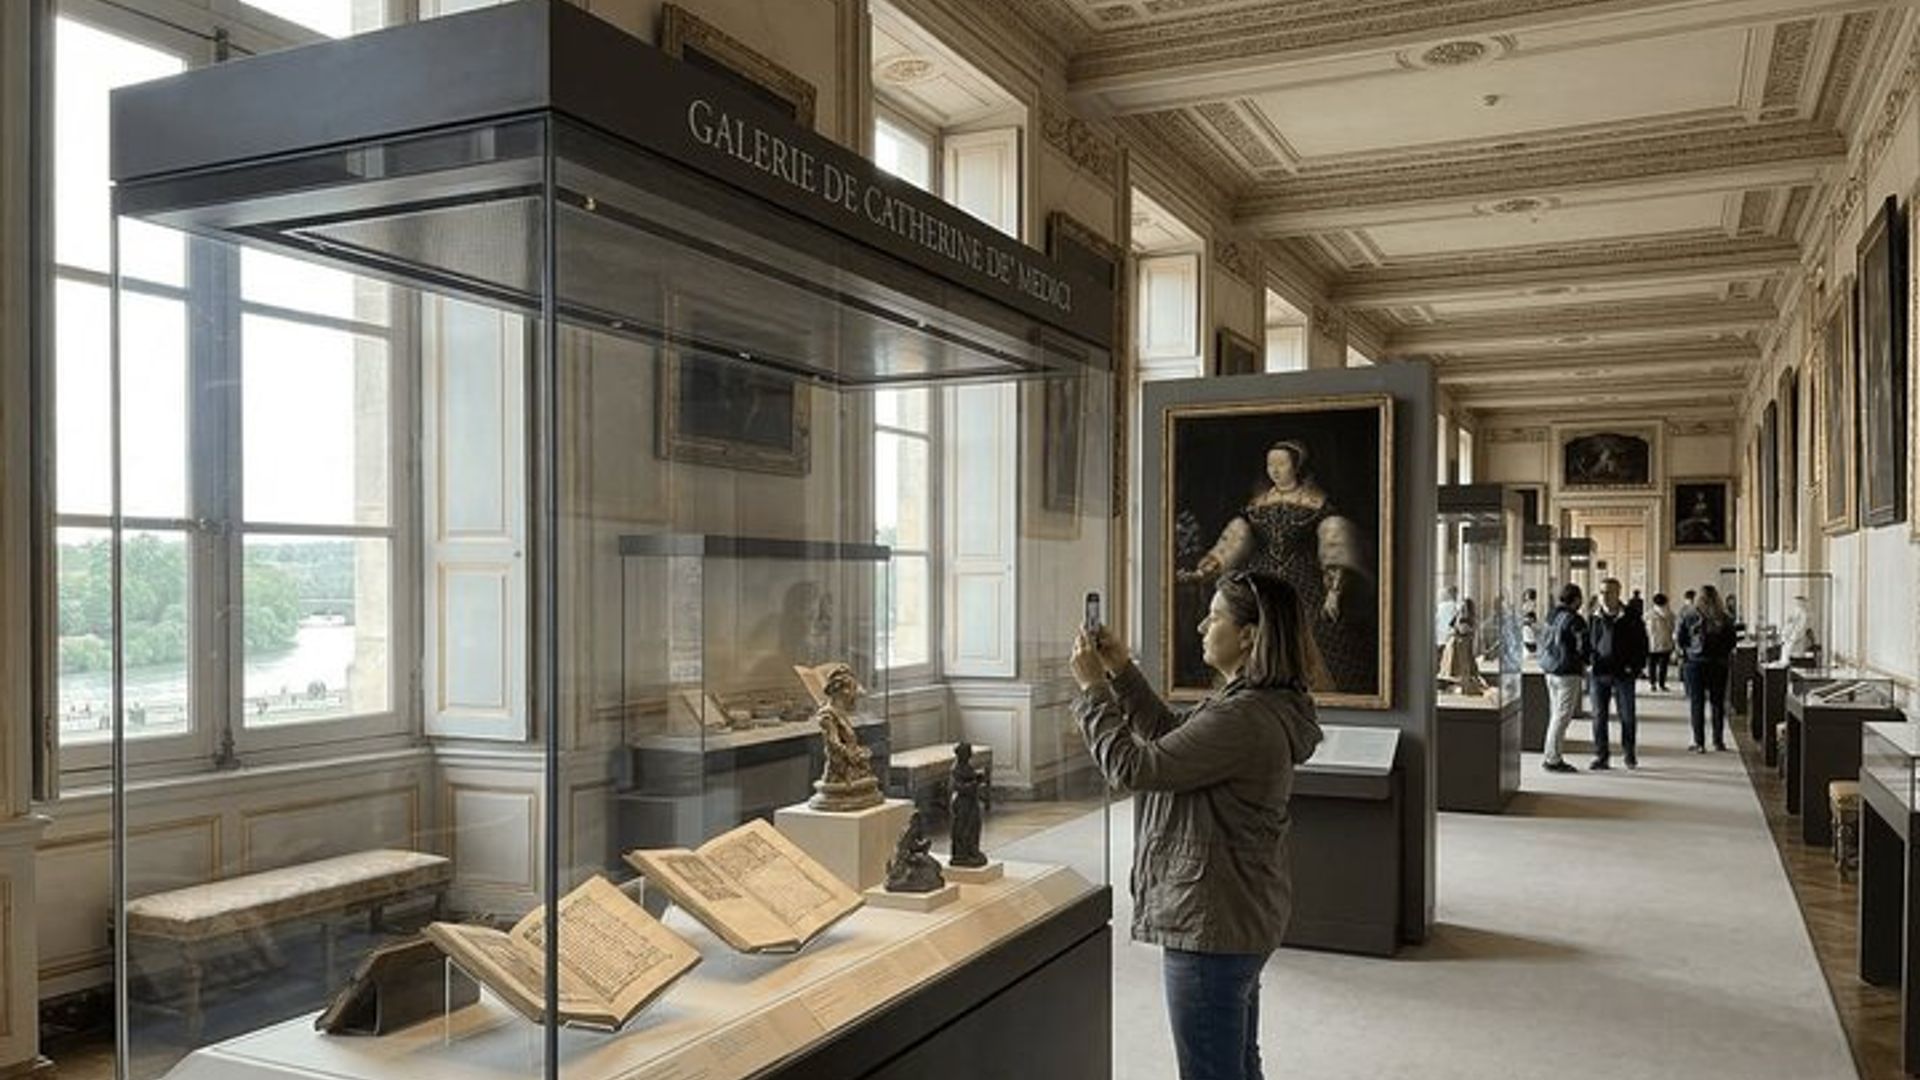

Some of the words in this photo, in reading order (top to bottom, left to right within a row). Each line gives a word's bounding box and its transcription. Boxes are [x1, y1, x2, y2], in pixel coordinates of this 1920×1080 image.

[688, 99, 815, 193] GALERIE
[823, 163, 859, 213] DE
[863, 185, 983, 272] CATHERINE
[1017, 261, 1071, 313] MEDICI
